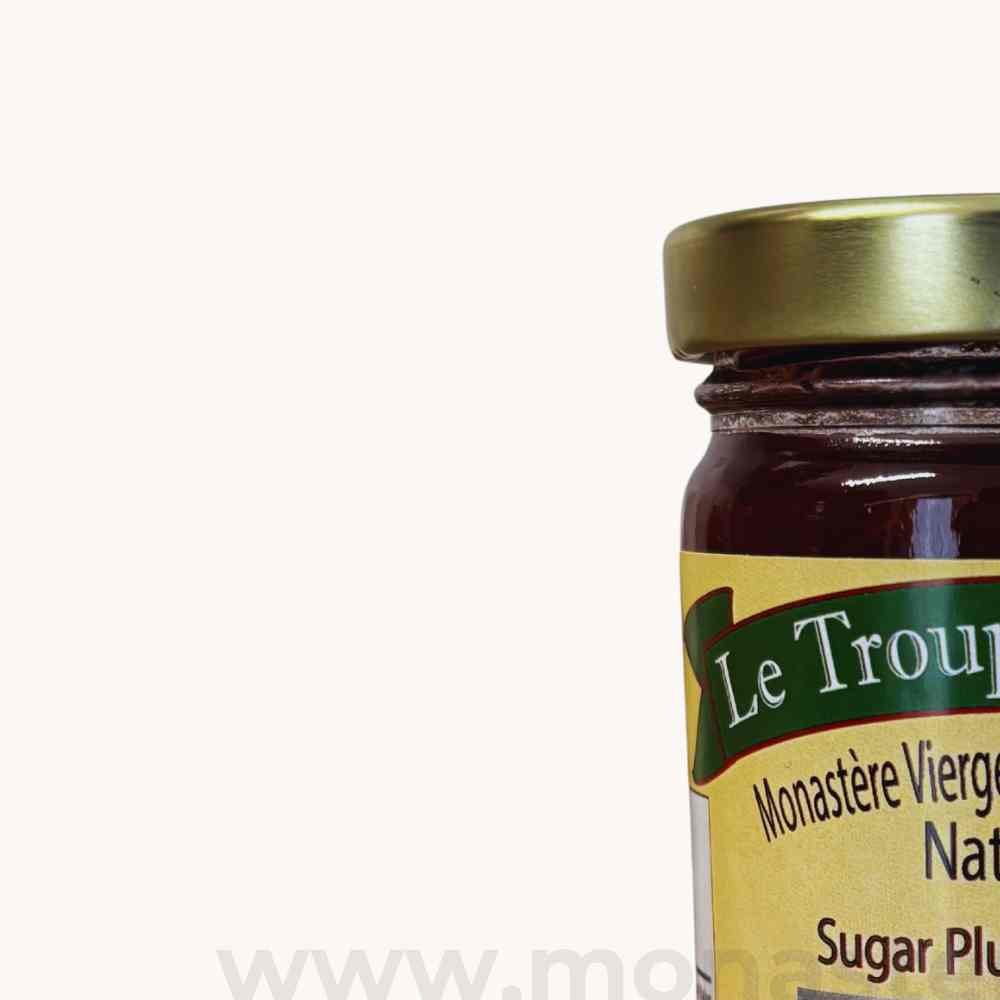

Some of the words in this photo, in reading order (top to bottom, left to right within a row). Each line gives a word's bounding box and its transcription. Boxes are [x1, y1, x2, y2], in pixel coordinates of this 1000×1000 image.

[713, 650, 787, 729] Le
[752, 747, 901, 843] Monastère
[816, 917, 934, 983] Sugar
